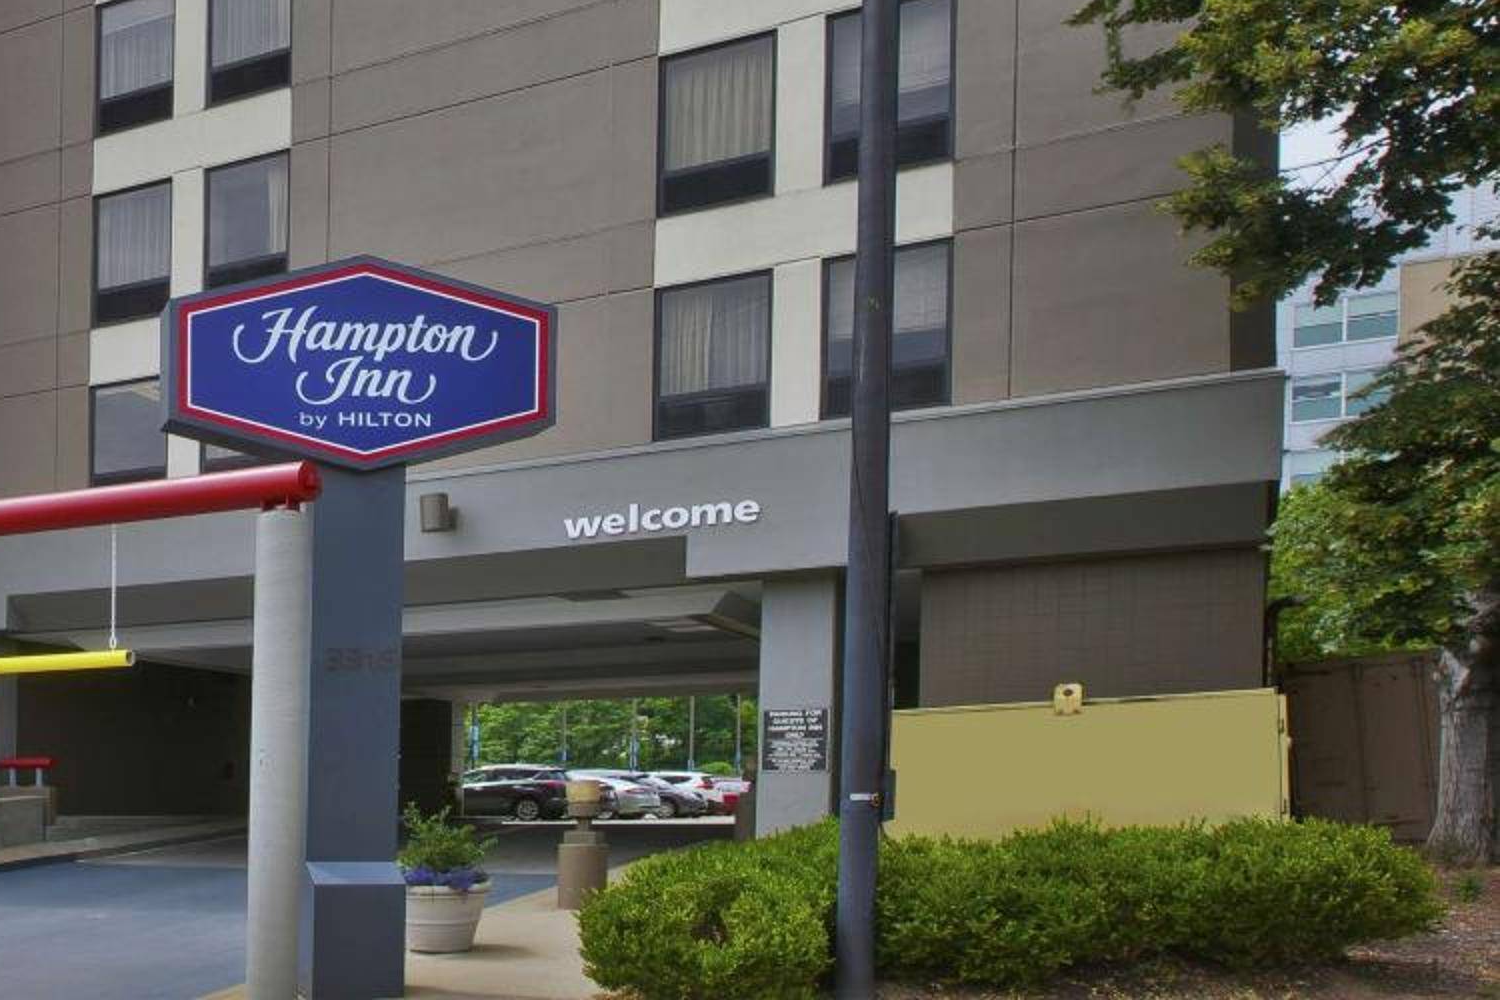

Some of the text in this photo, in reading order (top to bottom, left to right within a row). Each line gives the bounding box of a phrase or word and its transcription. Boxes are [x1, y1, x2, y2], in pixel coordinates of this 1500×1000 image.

[233, 305, 498, 363] Hampton
[296, 355, 437, 405] Inn
[300, 412, 432, 430] by HILTON
[563, 499, 762, 540] welcome
